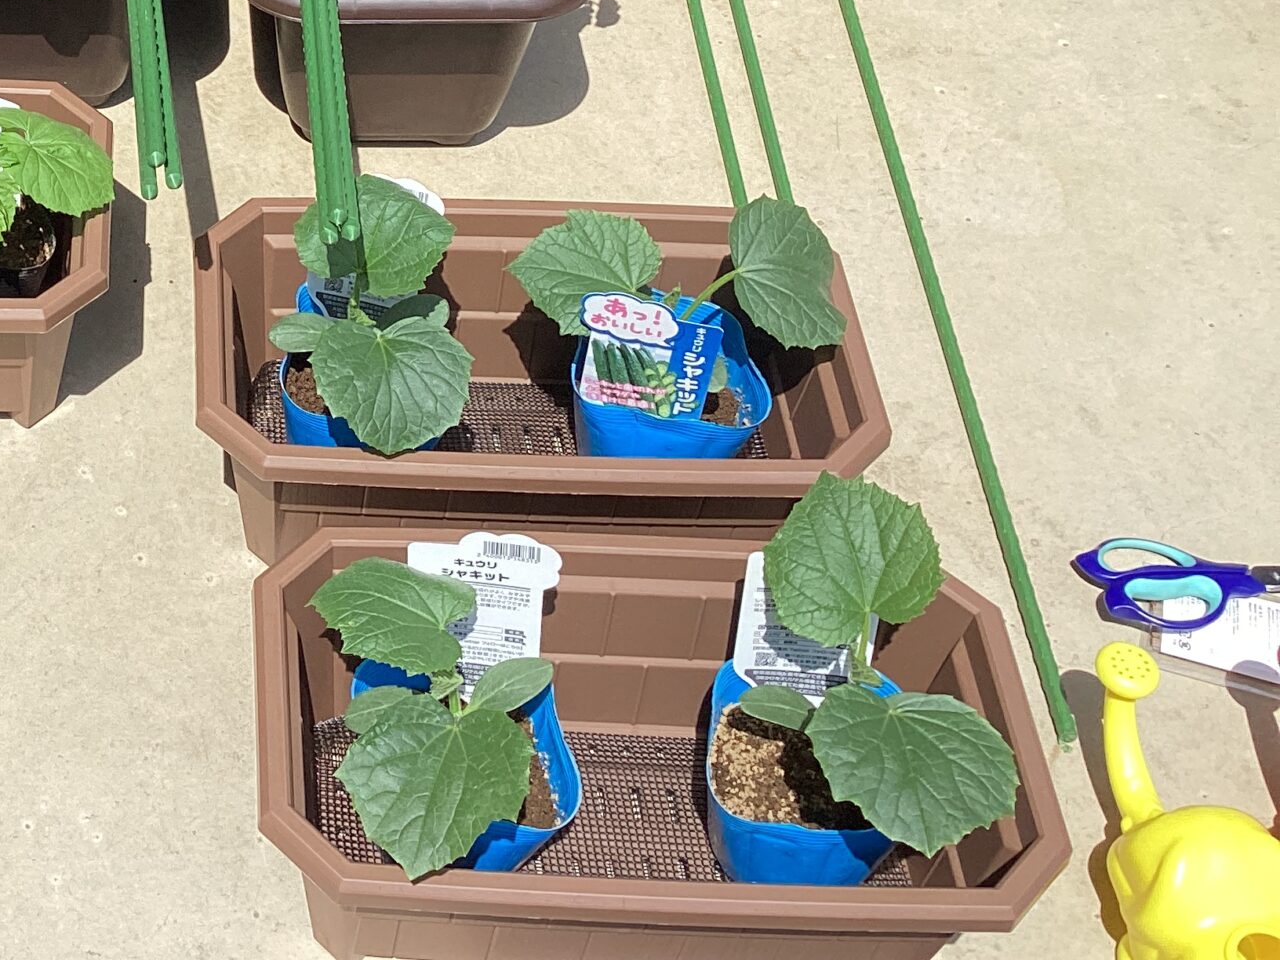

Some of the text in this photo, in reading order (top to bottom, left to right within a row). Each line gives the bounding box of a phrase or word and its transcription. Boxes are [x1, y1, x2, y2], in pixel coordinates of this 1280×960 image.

[590, 313, 662, 338] おいしい
[453, 558, 498, 569] キュウリ
[441, 567, 510, 582] シャキット
